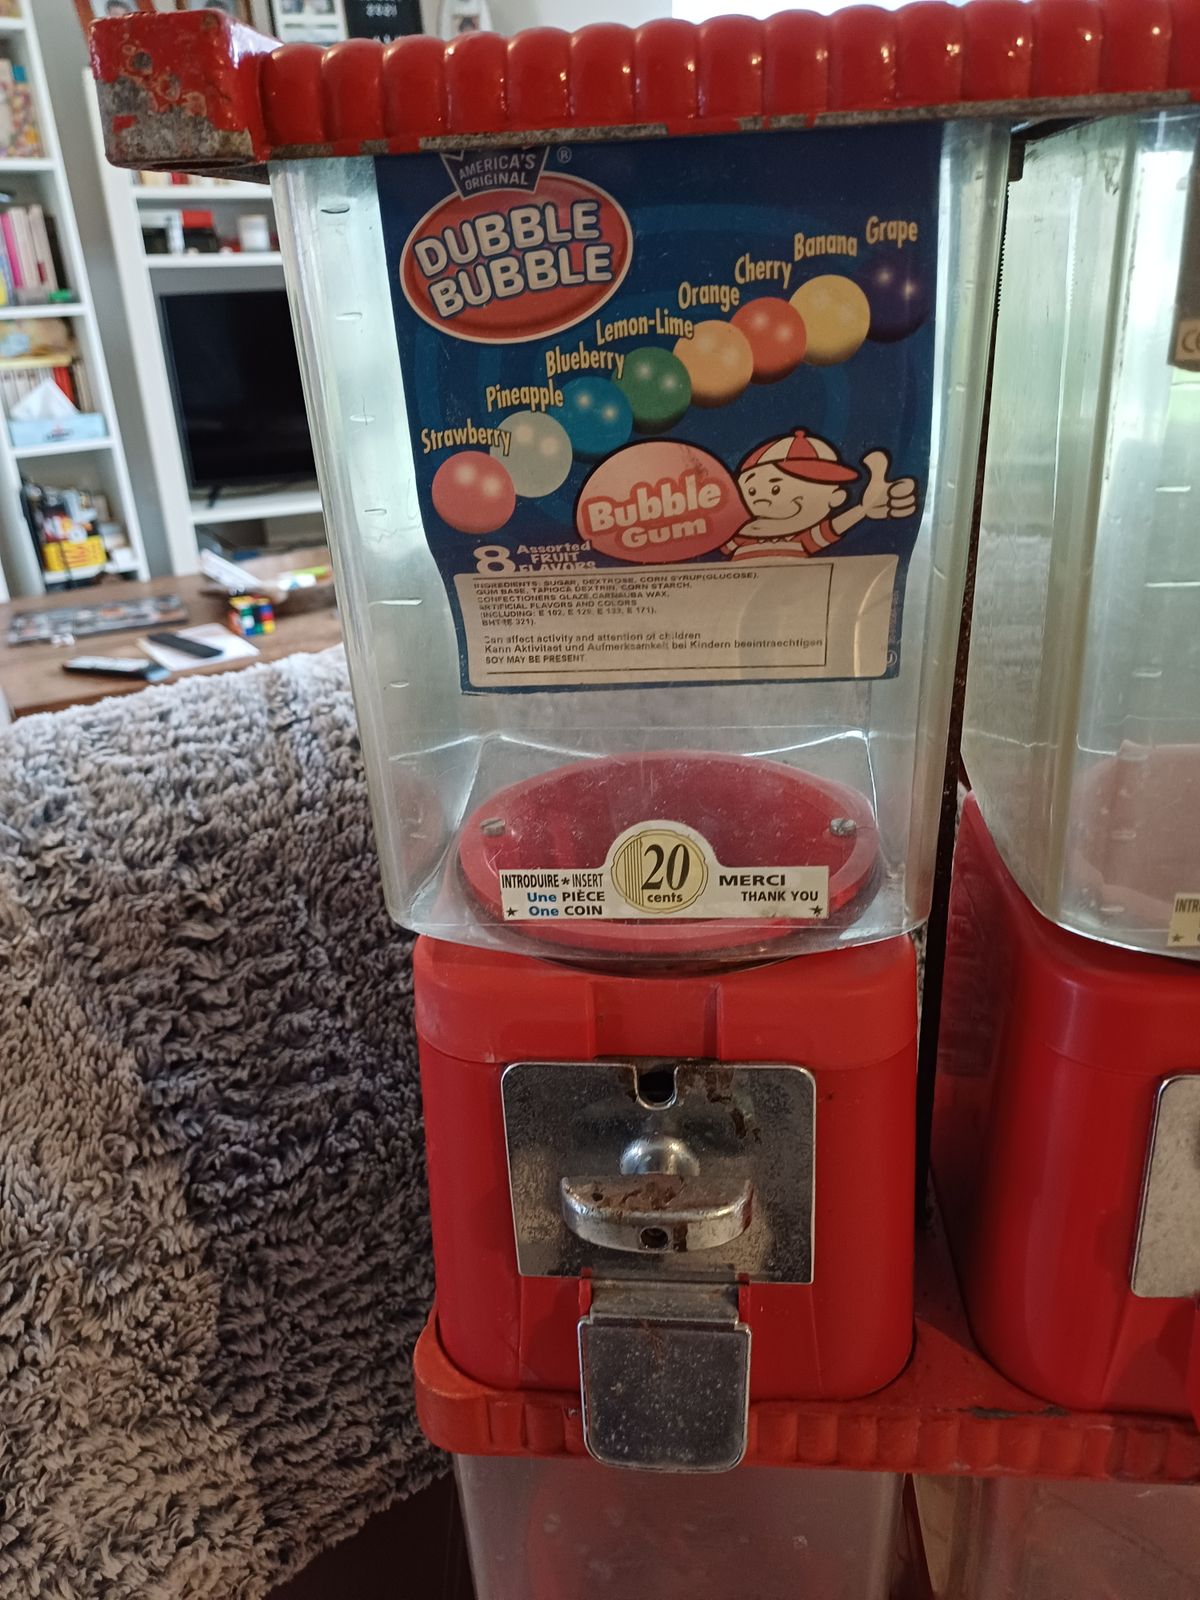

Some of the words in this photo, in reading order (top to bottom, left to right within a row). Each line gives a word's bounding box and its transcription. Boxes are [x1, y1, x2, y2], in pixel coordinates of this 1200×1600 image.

[459, 154, 536, 179] AMERICA'S
[465, 172, 529, 190] ORIGINAL
[413, 201, 600, 277] DUBBLE
[866, 215, 918, 248] Grape
[794, 232, 858, 262] Banana
[735, 253, 792, 290] Cherry
[429, 244, 613, 318] BUBBLE
[678, 281, 740, 312] Orange
[596, 308, 694, 346] Lemon-Lime
[545, 341, 625, 379] Blueberry
[486, 379, 564, 412] Pineapple
[421, 418, 511, 456] Strawberry
[587, 474, 722, 533] Bubble
[621, 516, 708, 549] Gum
[517, 541, 591, 554] Assorted
[473, 545, 516, 573] 8
[531, 552, 580, 564] FRUIT
[640, 575, 668, 583] CORN
[478, 594, 556, 603] CONFECTIONERS
[530, 601, 573, 609] FLAVORS
[597, 599, 637, 607] COLORS
[485, 644, 511, 653] Kann
[514, 643, 562, 652] Aktivitaet
[565, 642, 585, 652] und
[672, 639, 687, 649] bei
[690, 639, 731, 649] Kindern
[734, 637, 823, 649] beeintraechtigen
[506, 634, 534, 643] affect
[537, 633, 573, 644] activity
[576, 633, 594, 642] and
[597, 632, 643, 641] attention
[646, 632, 656, 641] of
[486, 656, 504, 664] SOY
[507, 655, 526, 664] MAY
[528, 655, 541, 663] BE
[641, 843, 691, 891] 20
[501, 873, 560, 888] INTRODUIRE
[572, 873, 603, 887] INSERT
[718, 874, 786, 887] MERCI
[527, 892, 557, 902] Une
[562, 889, 605, 902] PIÈCE
[647, 891, 683, 903] cents
[741, 891, 786, 902] THANK
[791, 891, 819, 902] YOU
[529, 905, 559, 916] One
[564, 905, 603, 916] COIN
[1175, 898, 1200, 912] INTR
